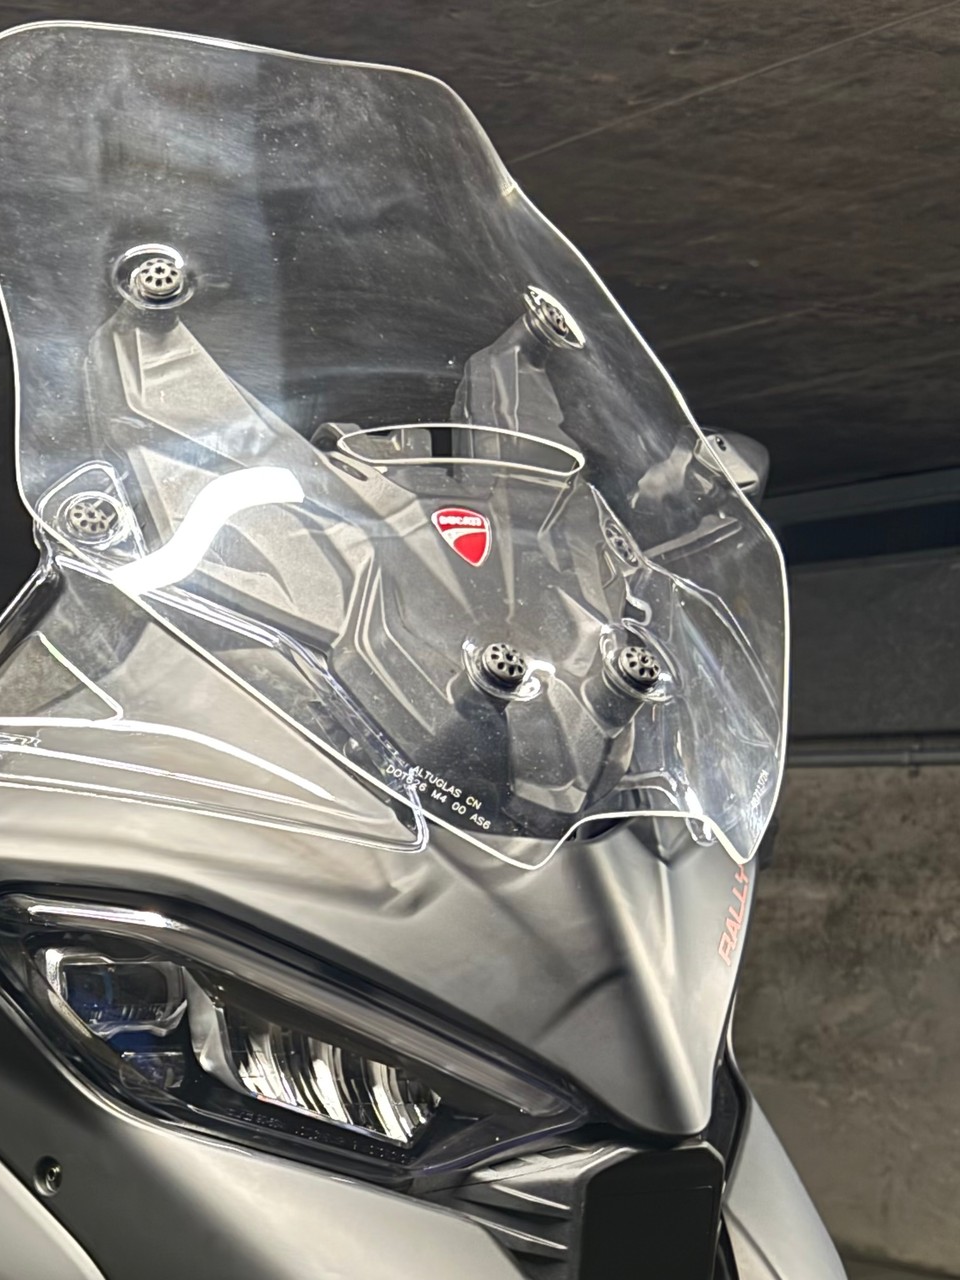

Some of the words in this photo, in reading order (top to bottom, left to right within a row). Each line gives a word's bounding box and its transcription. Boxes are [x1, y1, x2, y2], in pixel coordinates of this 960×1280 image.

[409, 765, 462, 798] ALTUGLAS
[465, 795, 482, 811] CN
[431, 789, 448, 803] M4
[470, 813, 492, 830] AS6
